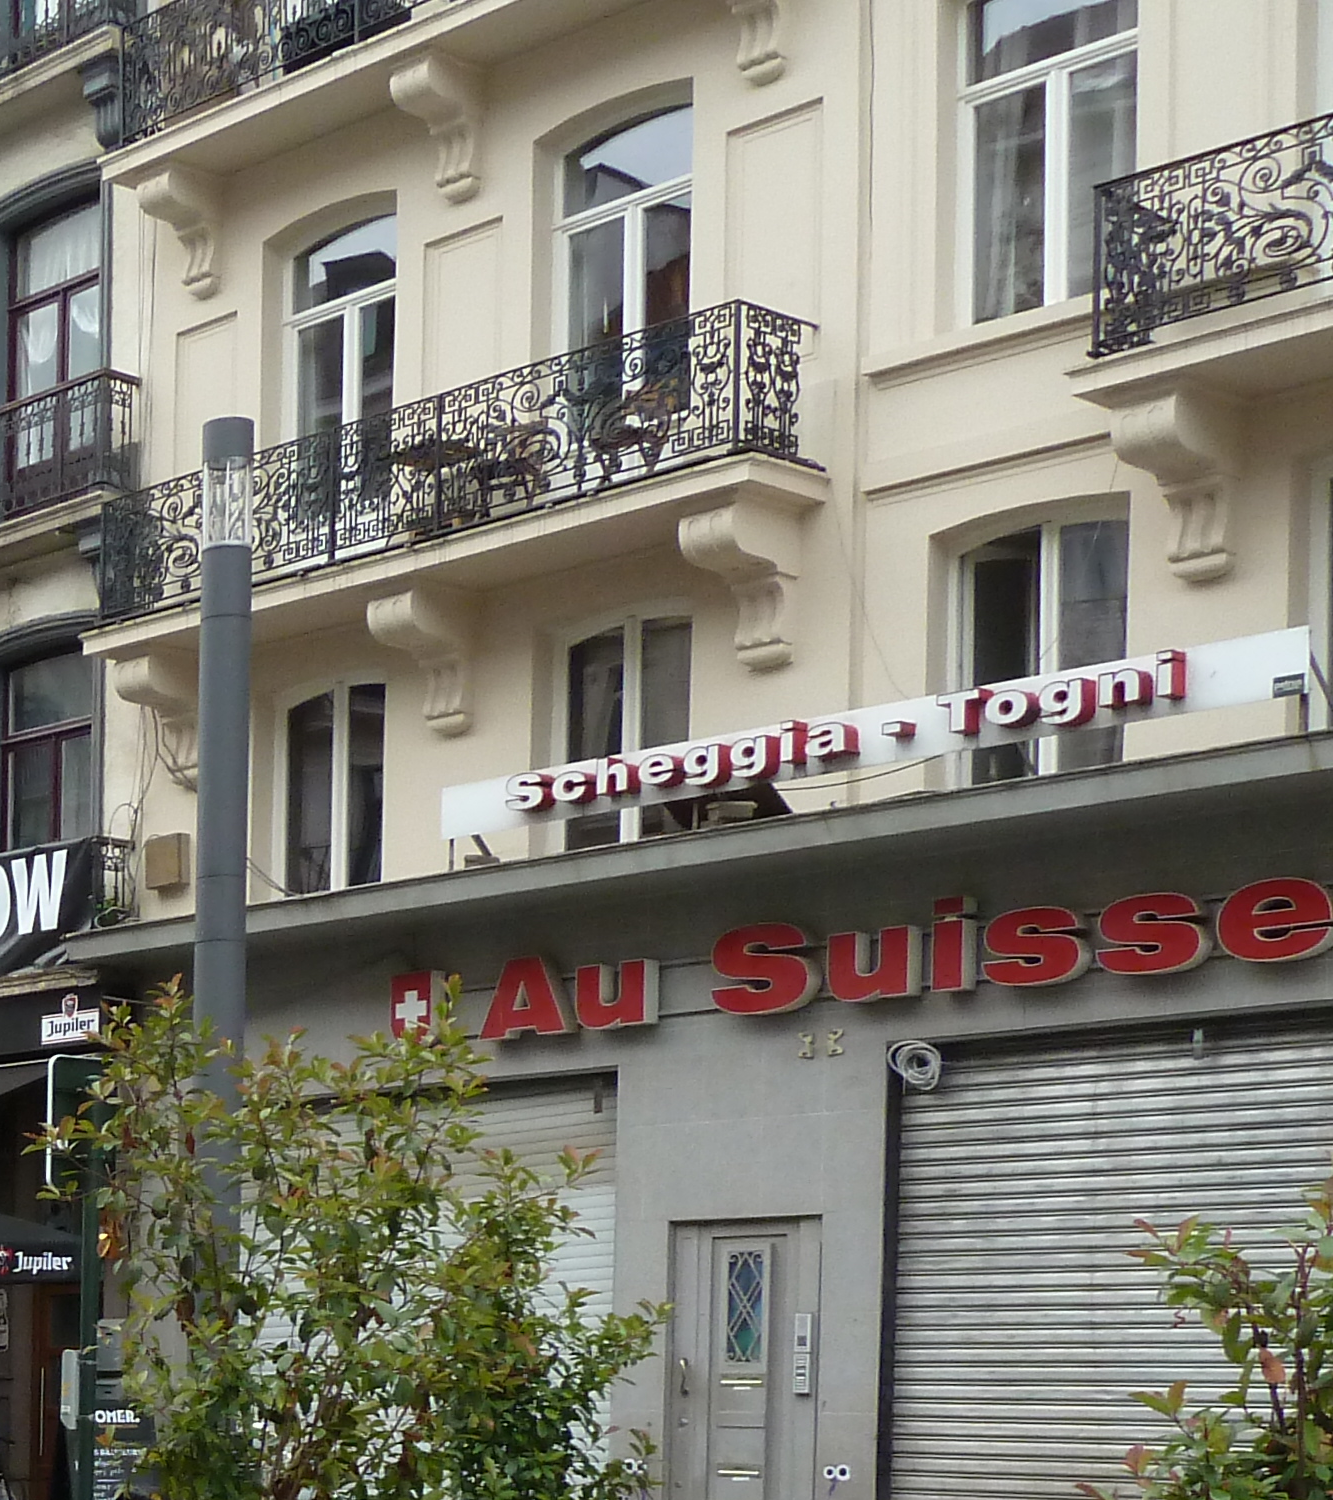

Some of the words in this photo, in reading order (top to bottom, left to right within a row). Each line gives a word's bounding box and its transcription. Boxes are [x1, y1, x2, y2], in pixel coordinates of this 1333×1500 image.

[504, 719, 860, 811] Scheggia
[936, 649, 1188, 736] Togni
[479, 955, 660, 1040] Au
[710, 875, 1333, 1016] Suisse
[46, 1017, 95, 1037] Jupiler
[12, 1251, 73, 1275] Jupiler
